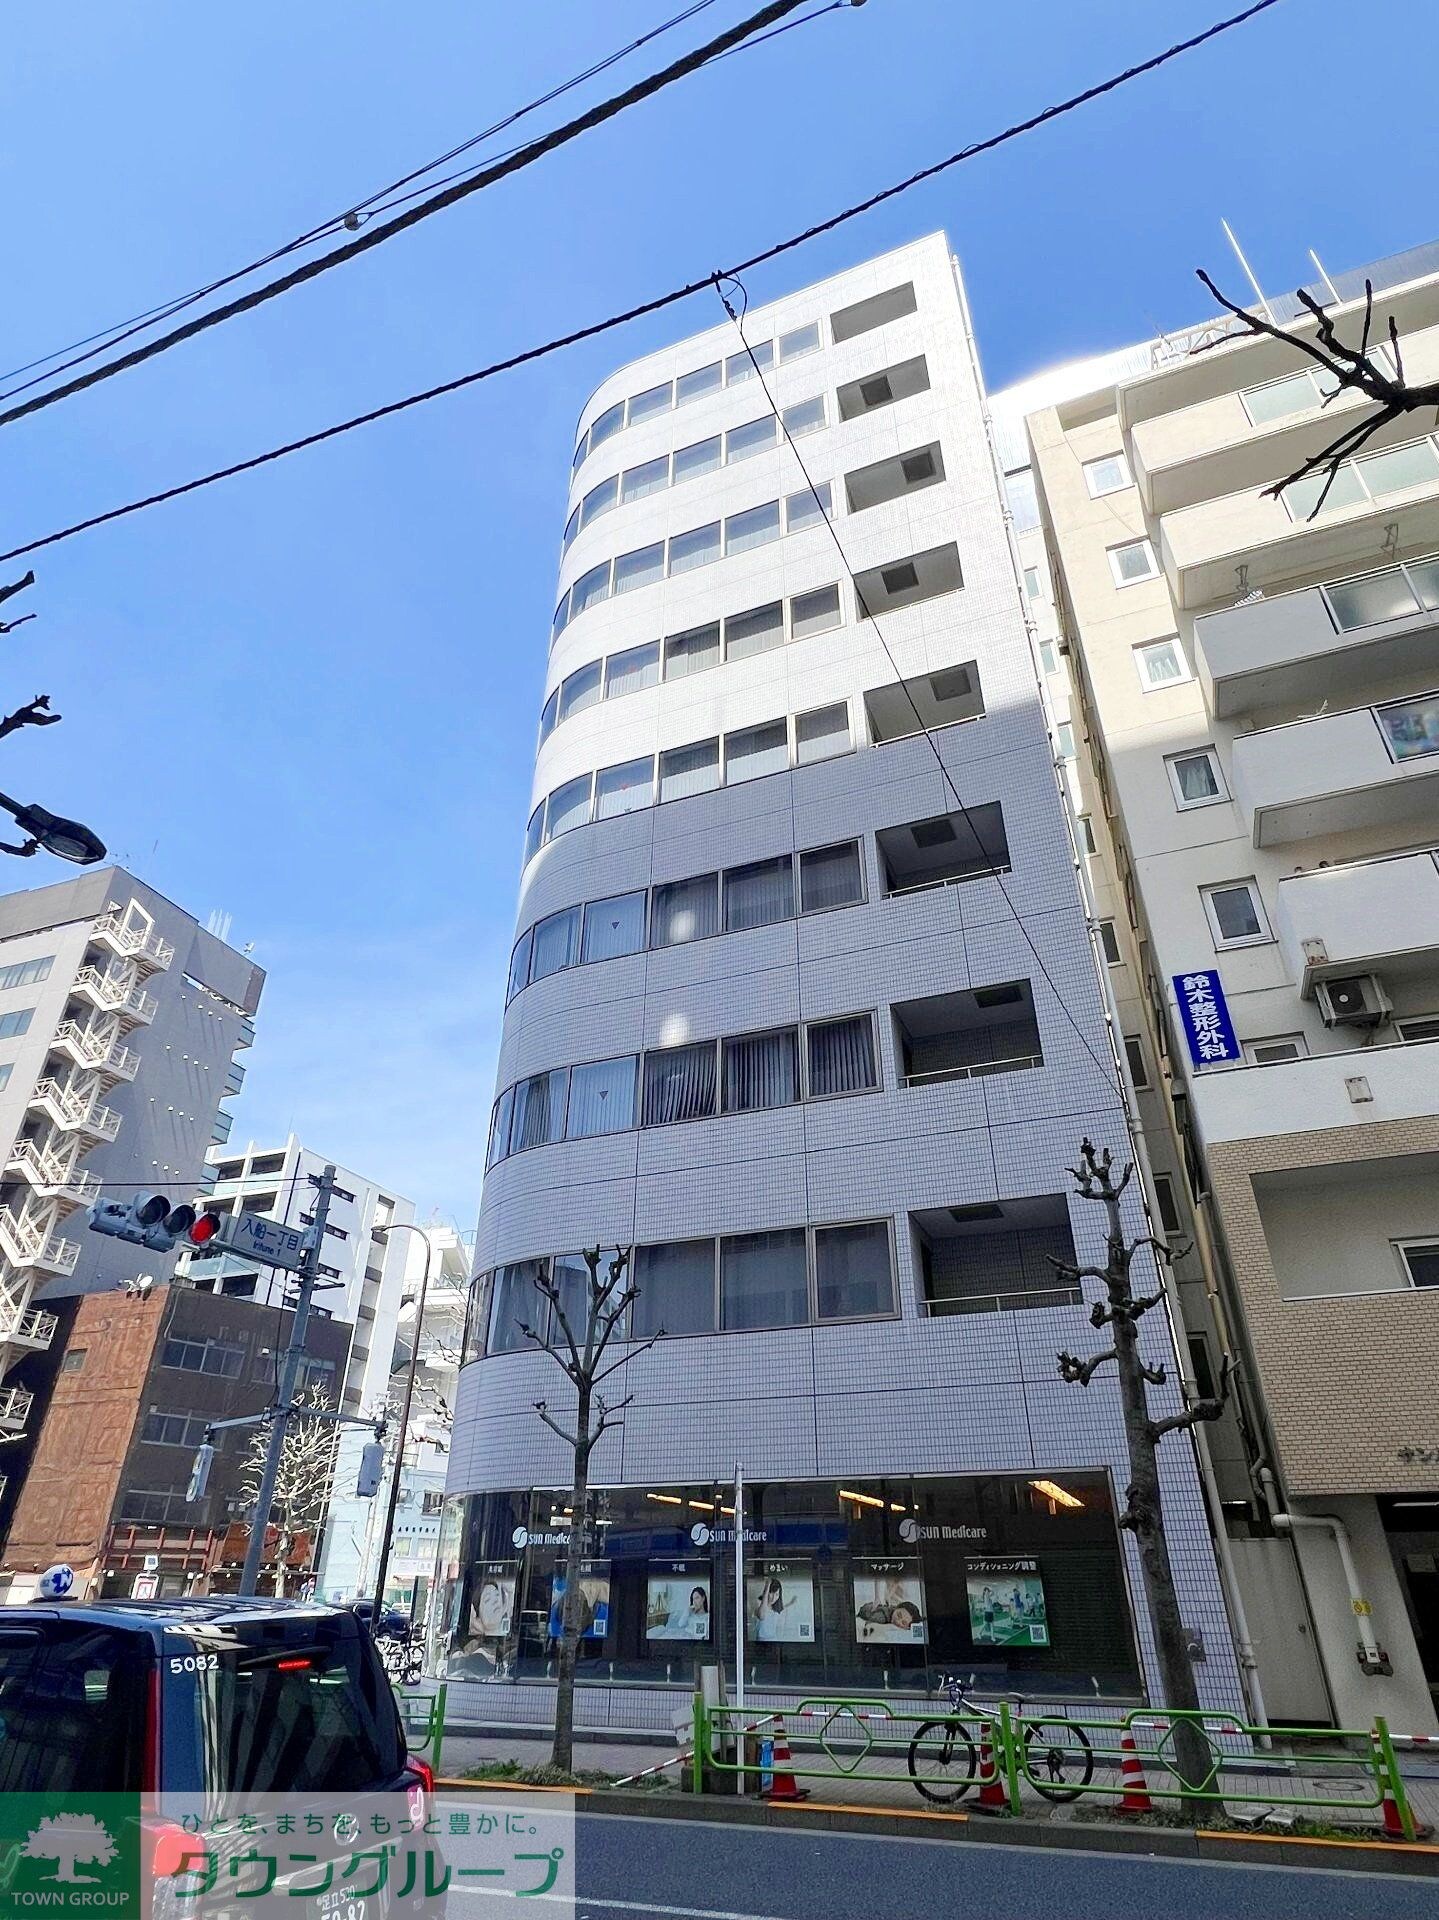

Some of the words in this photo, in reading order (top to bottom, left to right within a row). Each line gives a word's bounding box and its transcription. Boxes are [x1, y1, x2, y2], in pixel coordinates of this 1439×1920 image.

[1182, 974, 1229, 1060] 鈴木整形外科
[241, 1217, 299, 1250] 入船一丁目
[728, 1529, 768, 1542] Mdicare
[170, 1655, 219, 1674] 5082
